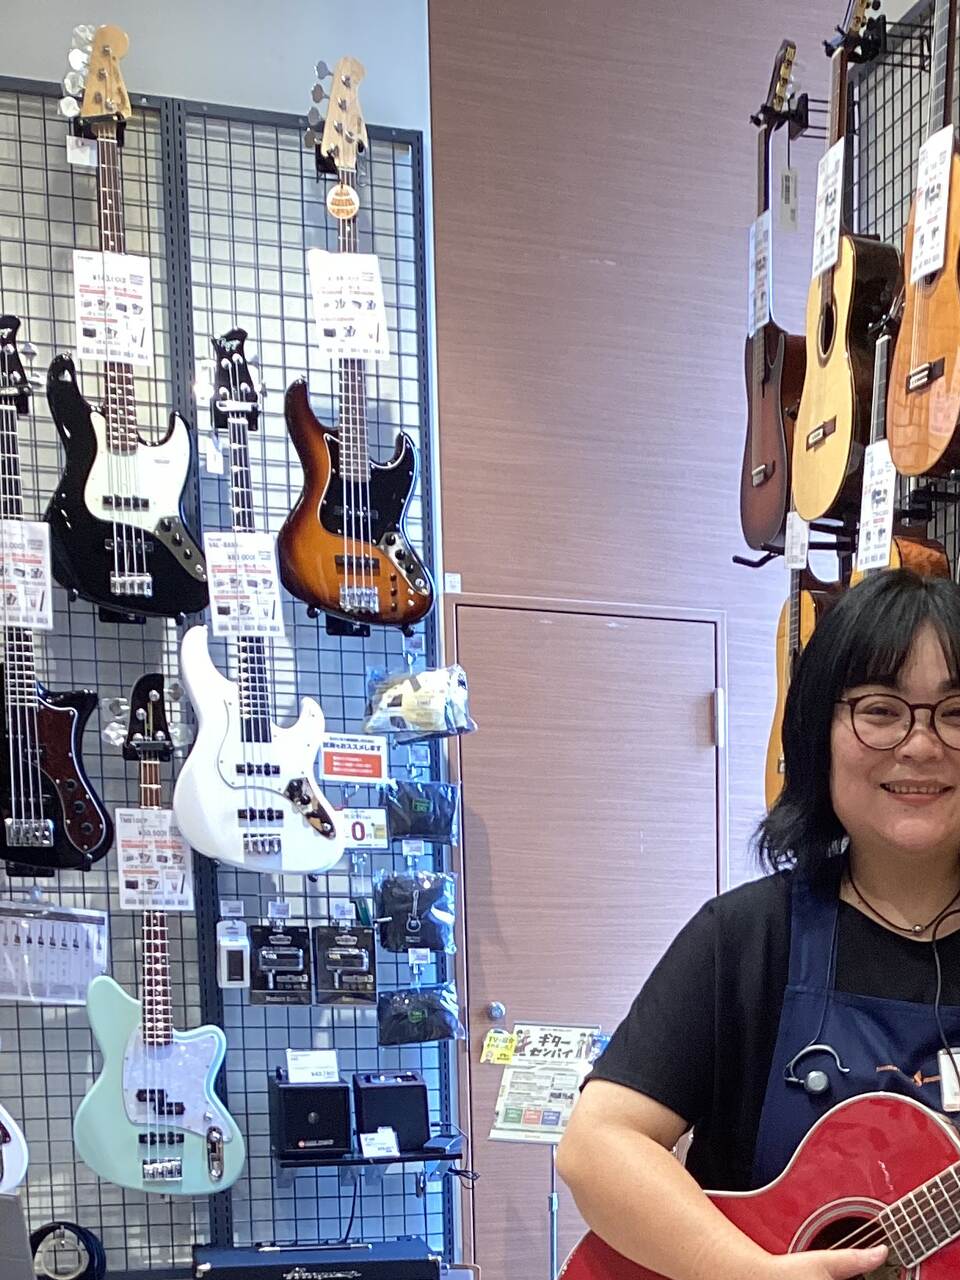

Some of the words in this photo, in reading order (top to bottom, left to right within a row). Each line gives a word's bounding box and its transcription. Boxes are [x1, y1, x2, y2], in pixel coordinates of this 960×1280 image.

[538, 1033, 571, 1047] ギター
[529, 1047, 573, 1059] センパイ
